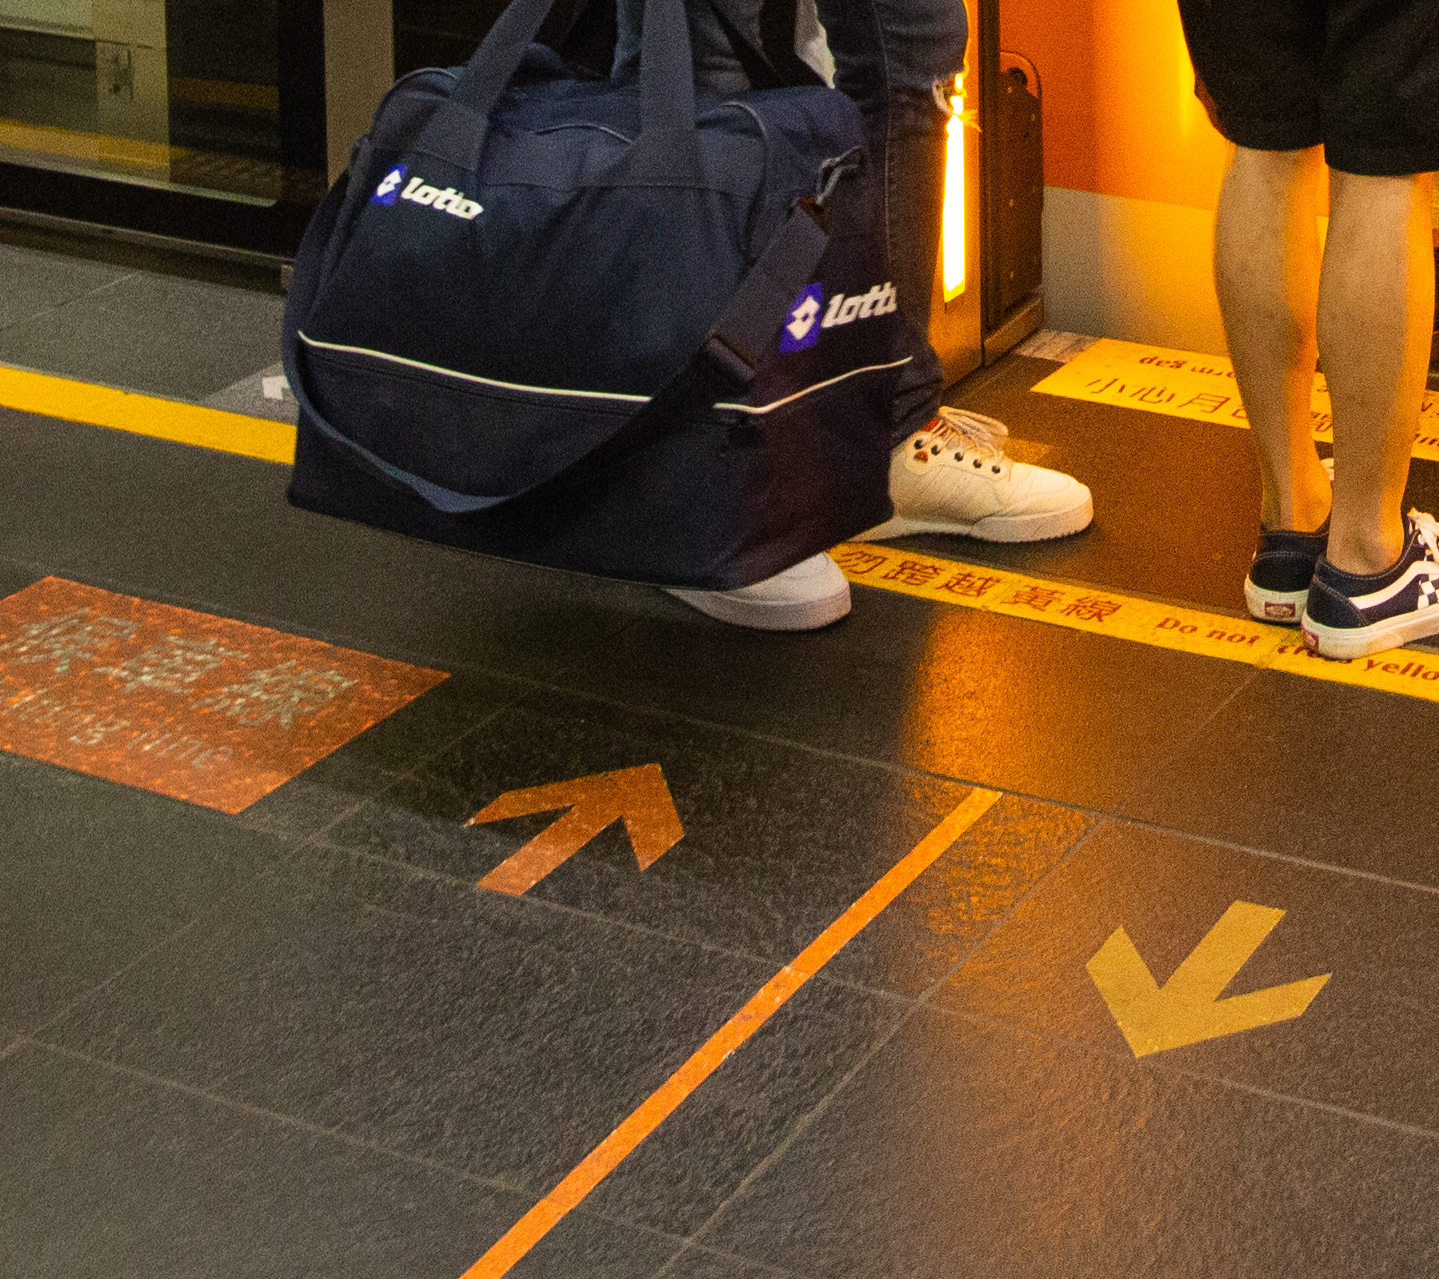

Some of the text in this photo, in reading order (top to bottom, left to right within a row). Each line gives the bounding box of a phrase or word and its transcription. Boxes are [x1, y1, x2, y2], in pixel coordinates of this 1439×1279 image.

[401, 176, 485, 220] lotto
[837, 549, 1123, 623] 勿跨越黃線
[1155, 616, 1198, 635] Do
[1206, 628, 1261, 648] not
